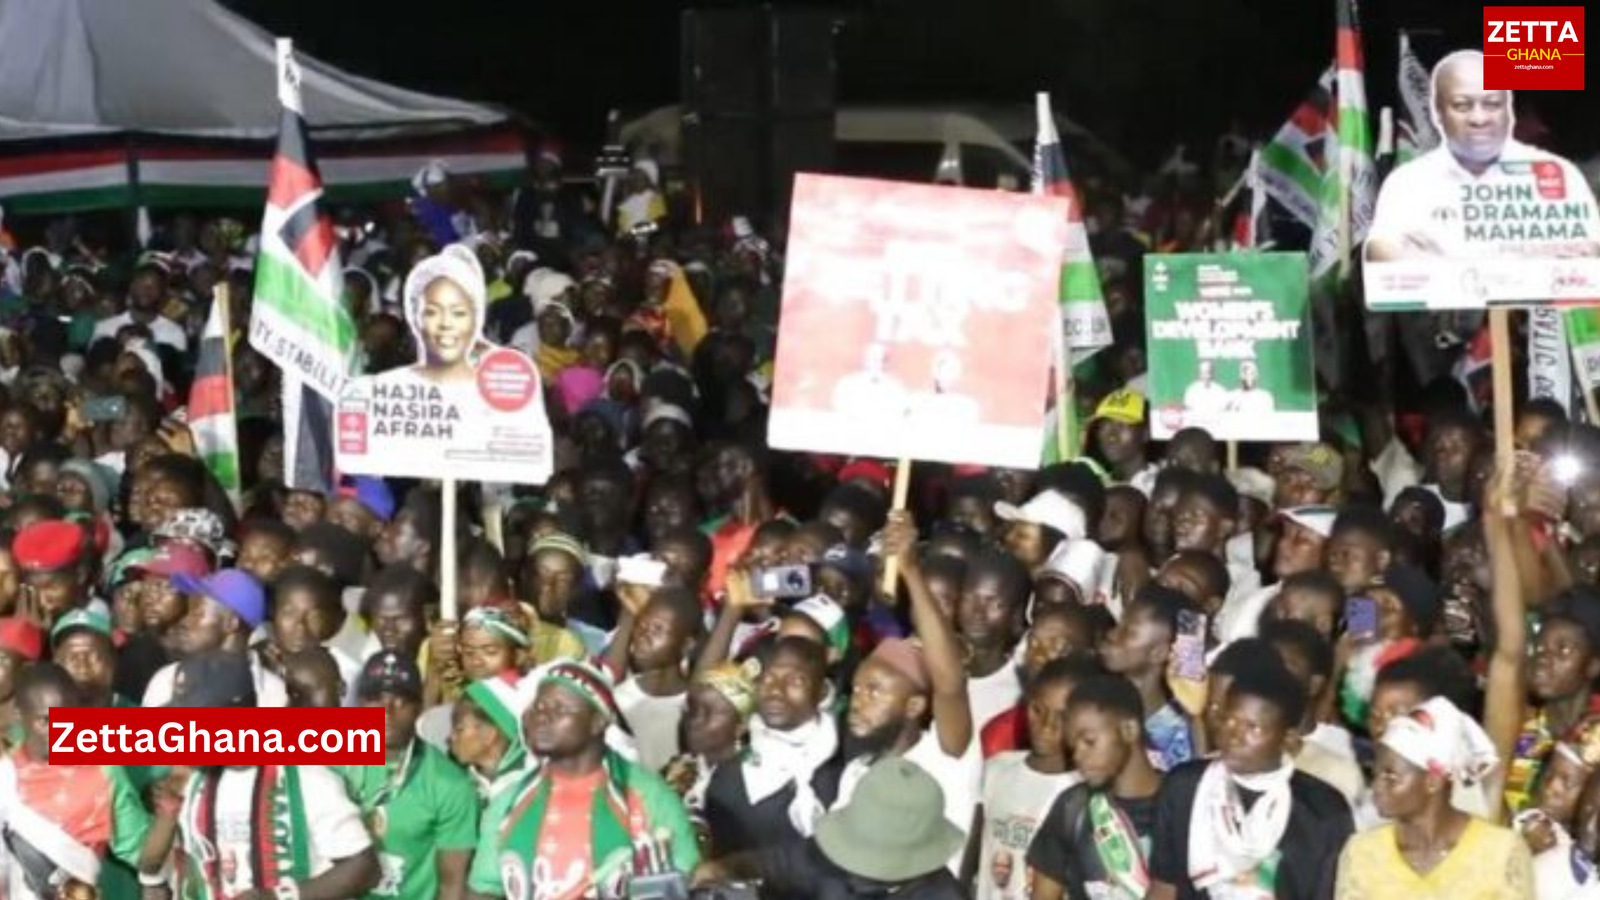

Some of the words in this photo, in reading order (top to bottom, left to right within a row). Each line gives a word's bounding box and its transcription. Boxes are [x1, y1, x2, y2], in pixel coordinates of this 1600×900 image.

[1460, 183, 1533, 201] JOHN
[1462, 202, 1590, 222] DRAMANI
[1464, 221, 1588, 242] MAHAMA
[1151, 320, 1301, 339] DEVELOPMENT
[372, 383, 442, 402] HAJIA
[373, 401, 461, 421] NASIRA
[373, 420, 454, 440] AFRAH
